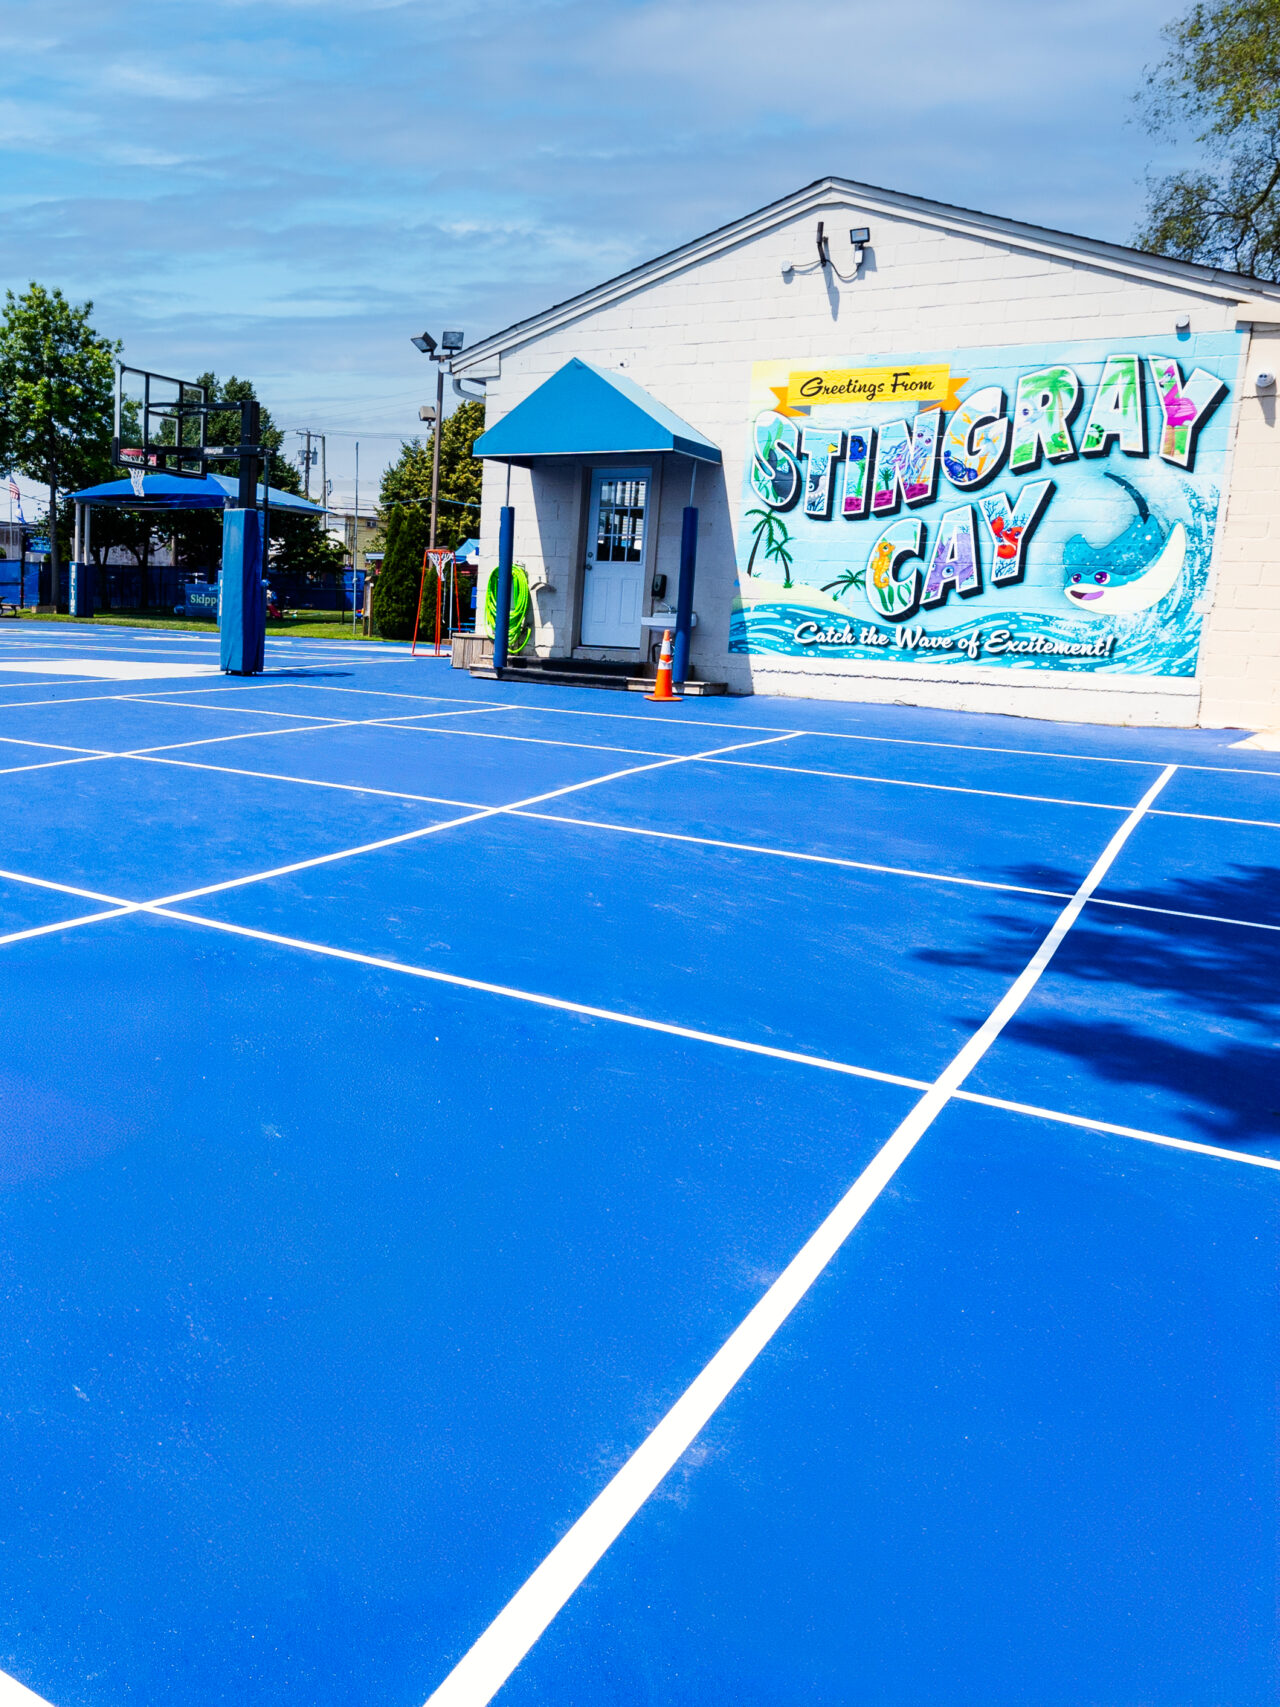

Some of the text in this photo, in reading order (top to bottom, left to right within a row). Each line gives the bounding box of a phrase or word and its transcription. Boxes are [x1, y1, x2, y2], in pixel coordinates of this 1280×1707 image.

[800, 371, 935, 401] Greetings From
[750, 354, 1231, 519] STINGRAY
[865, 479, 1057, 622] CAY
[190, 593, 219, 607] Skipp
[794, 621, 1116, 660] Catch the Wave of Excitement!
